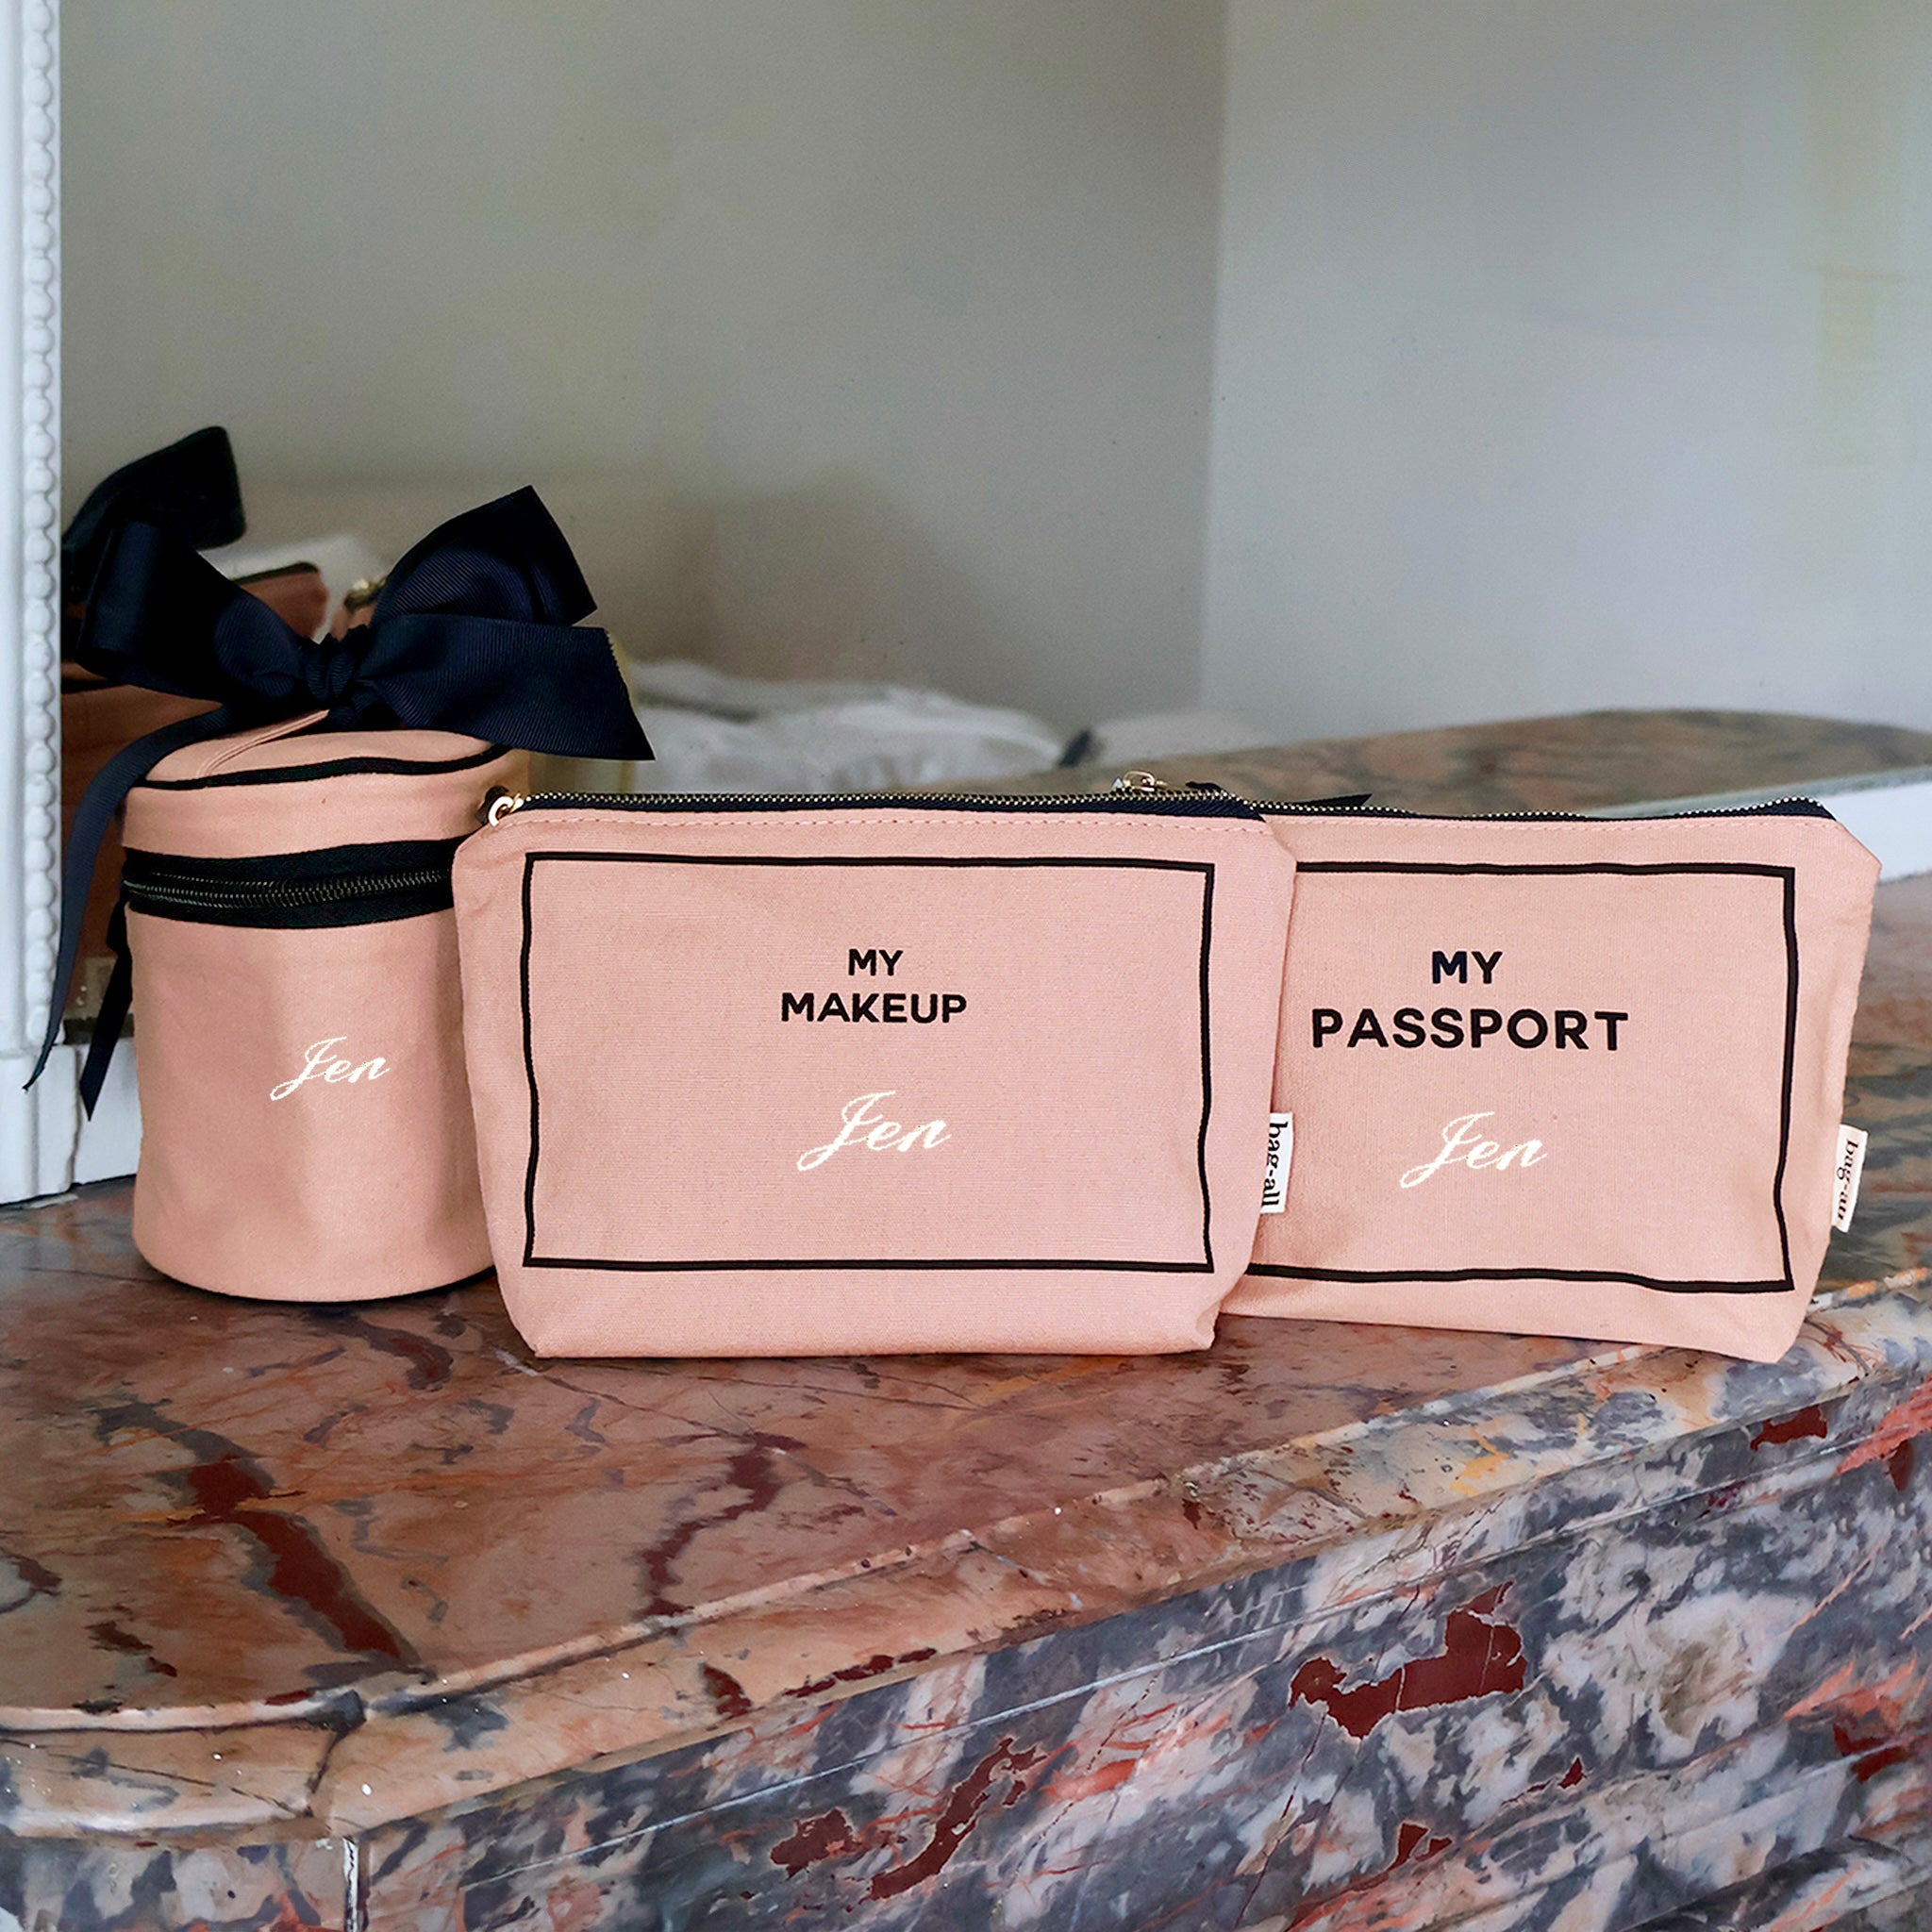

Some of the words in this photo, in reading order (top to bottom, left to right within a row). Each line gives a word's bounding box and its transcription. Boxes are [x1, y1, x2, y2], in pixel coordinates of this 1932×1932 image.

[849, 948, 904, 976] MY
[1432, 950, 1503, 985] MY
[781, 992, 967, 1024] MAKEUP
[1311, 1007, 1628, 1051] PASSPORT
[269, 1036, 391, 1101] Jen
[796, 1091, 953, 1172] Jen
[1399, 1111, 1549, 1189] Jen
